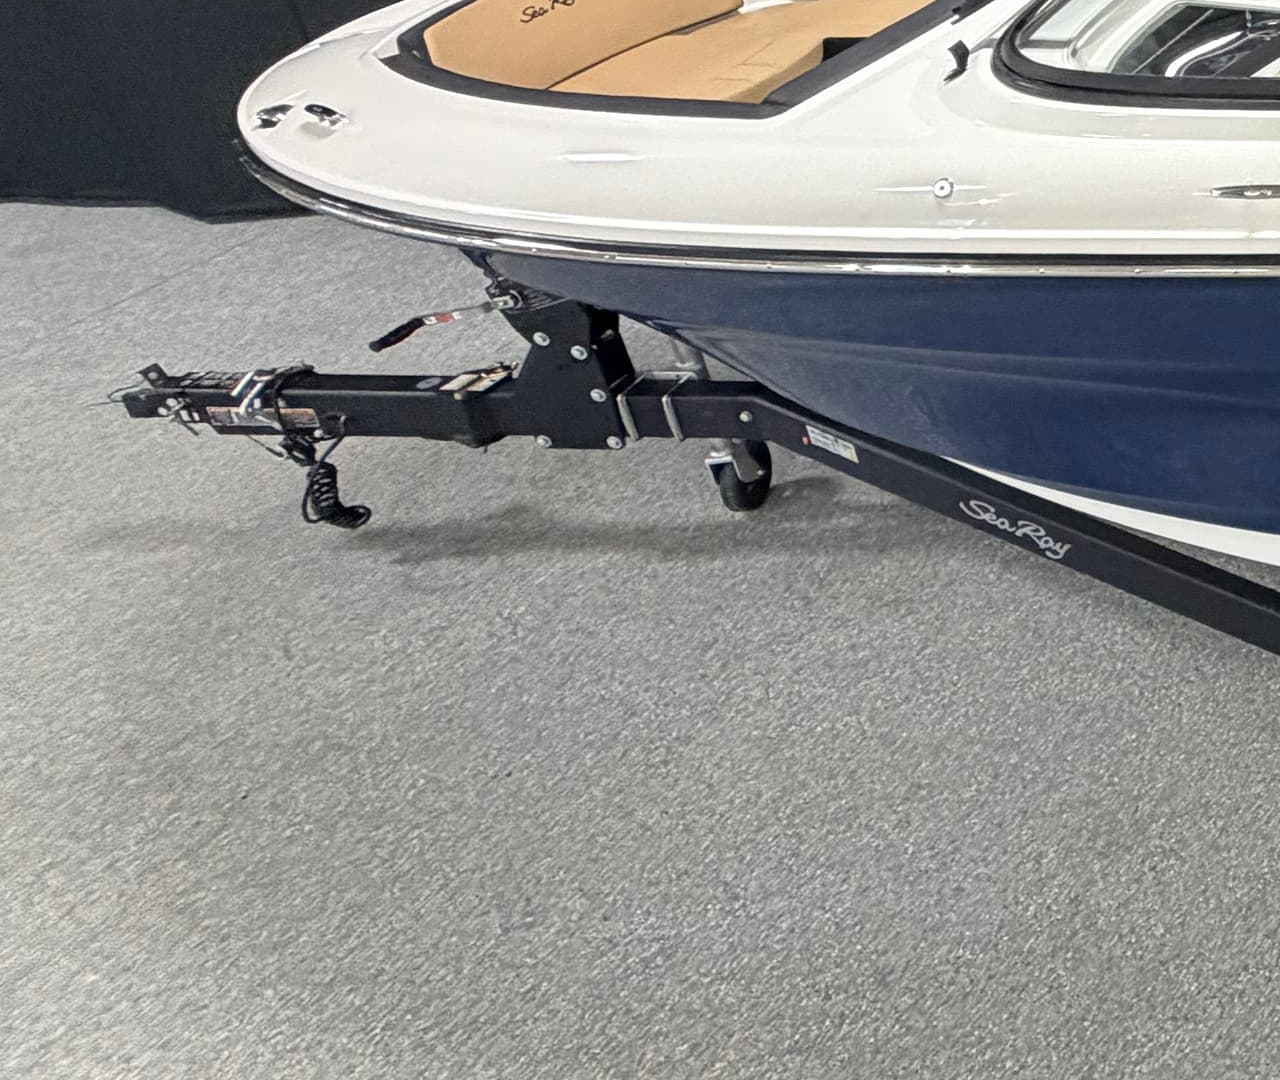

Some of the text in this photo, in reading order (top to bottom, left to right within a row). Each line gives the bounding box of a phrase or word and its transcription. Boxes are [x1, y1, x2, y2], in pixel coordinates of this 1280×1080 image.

[520, 5, 549, 23] Sea
[959, 500, 1072, 559] Sea Ray
